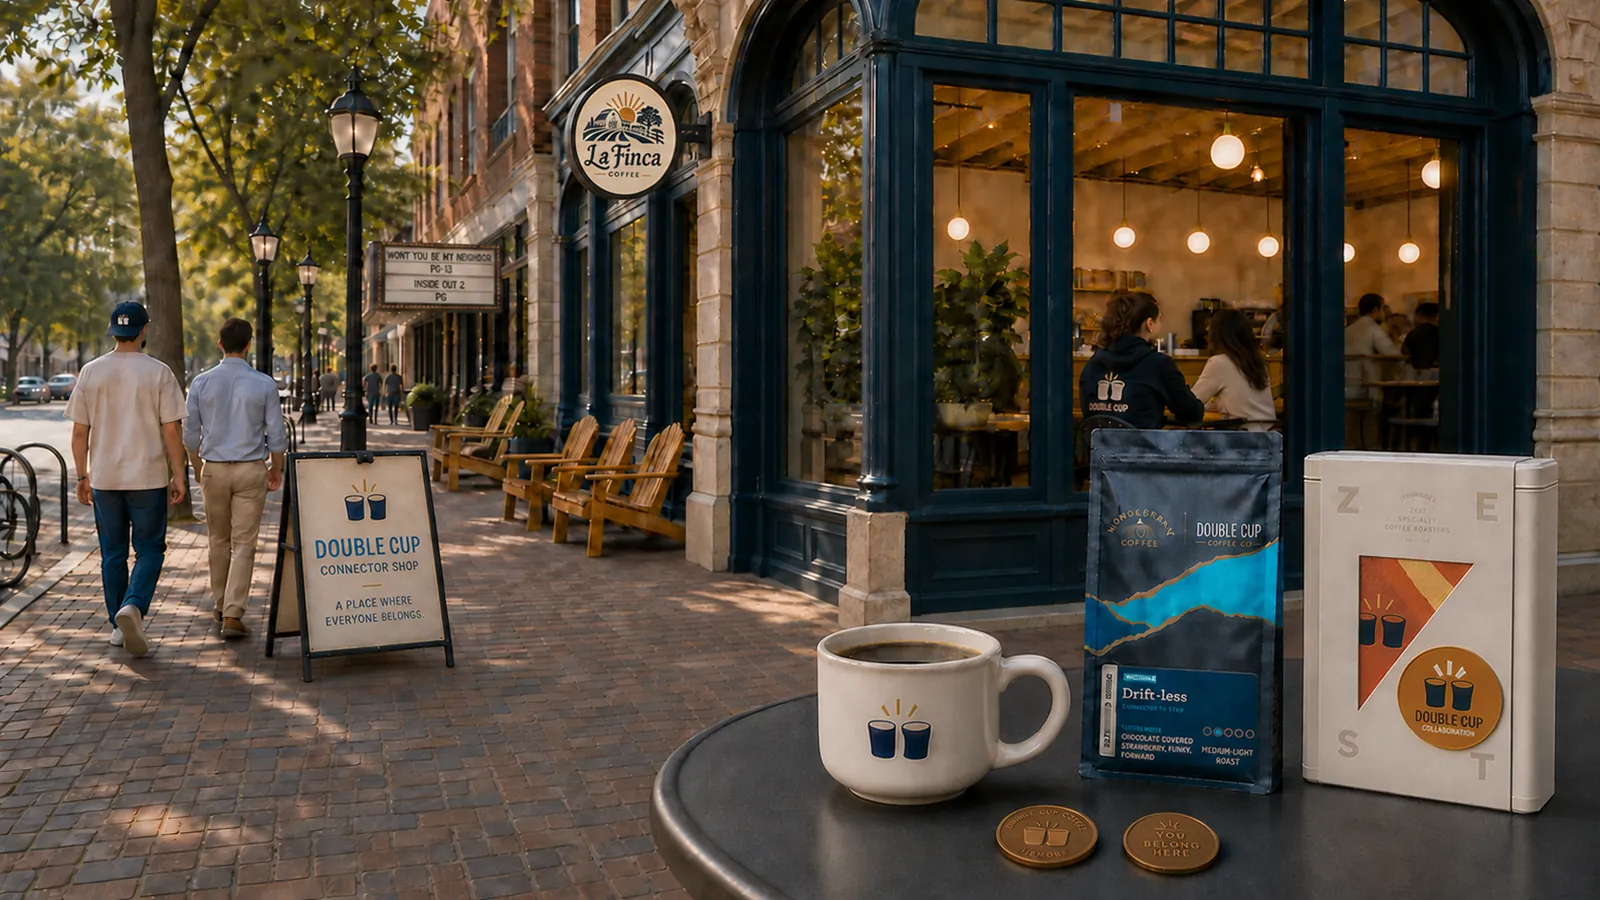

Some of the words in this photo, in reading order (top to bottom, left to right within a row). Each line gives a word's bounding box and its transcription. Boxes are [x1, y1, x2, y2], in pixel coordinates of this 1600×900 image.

[584, 143, 610, 170] La
[611, 143, 662, 169] Finca
[387, 251, 410, 260] WONT
[413, 251, 428, 260] YOU
[431, 252, 439, 261] BE
[442, 253, 453, 262] MY
[414, 279, 440, 289] INSIDE
[442, 280, 457, 289] OUT
[459, 280, 465, 289] 2
[435, 292, 447, 301] PG
[1337, 485, 1360, 514] Z
[1476, 491, 1498, 522] E
[1196, 522, 1238, 538] DOUBLE
[1240, 523, 1262, 539] CUP
[315, 537, 386, 560] DOUBLE
[389, 535, 421, 555] CUP
[1121, 539, 1159, 548] COFFEE
[320, 561, 389, 576] CONNECTOR
[392, 560, 419, 573] SHOP
[335, 601, 343, 611] A
[346, 597, 378, 610] PLACE
[379, 595, 412, 608] WHERE
[325, 612, 378, 627] EVERYONE
[381, 610, 425, 623] BELONGS.
[1122, 687, 1188, 703] Drift-less
[1415, 709, 1458, 727] DOUBLE
[1460, 714, 1484, 729] CUP
[1421, 724, 1476, 738] COLLABORATION
[1161, 736, 1194, 744] COVERED
[1337, 729, 1360, 758] S
[1121, 751, 1155, 761] FORWARD
[1201, 745, 1254, 757] MEDIUM-LIGHT
[1215, 757, 1240, 766] ROAST
[1470, 751, 1495, 780] T
[1155, 831, 1185, 840] YOU
[1143, 840, 1200, 850] BELONG
[1153, 848, 1190, 857] HERE
